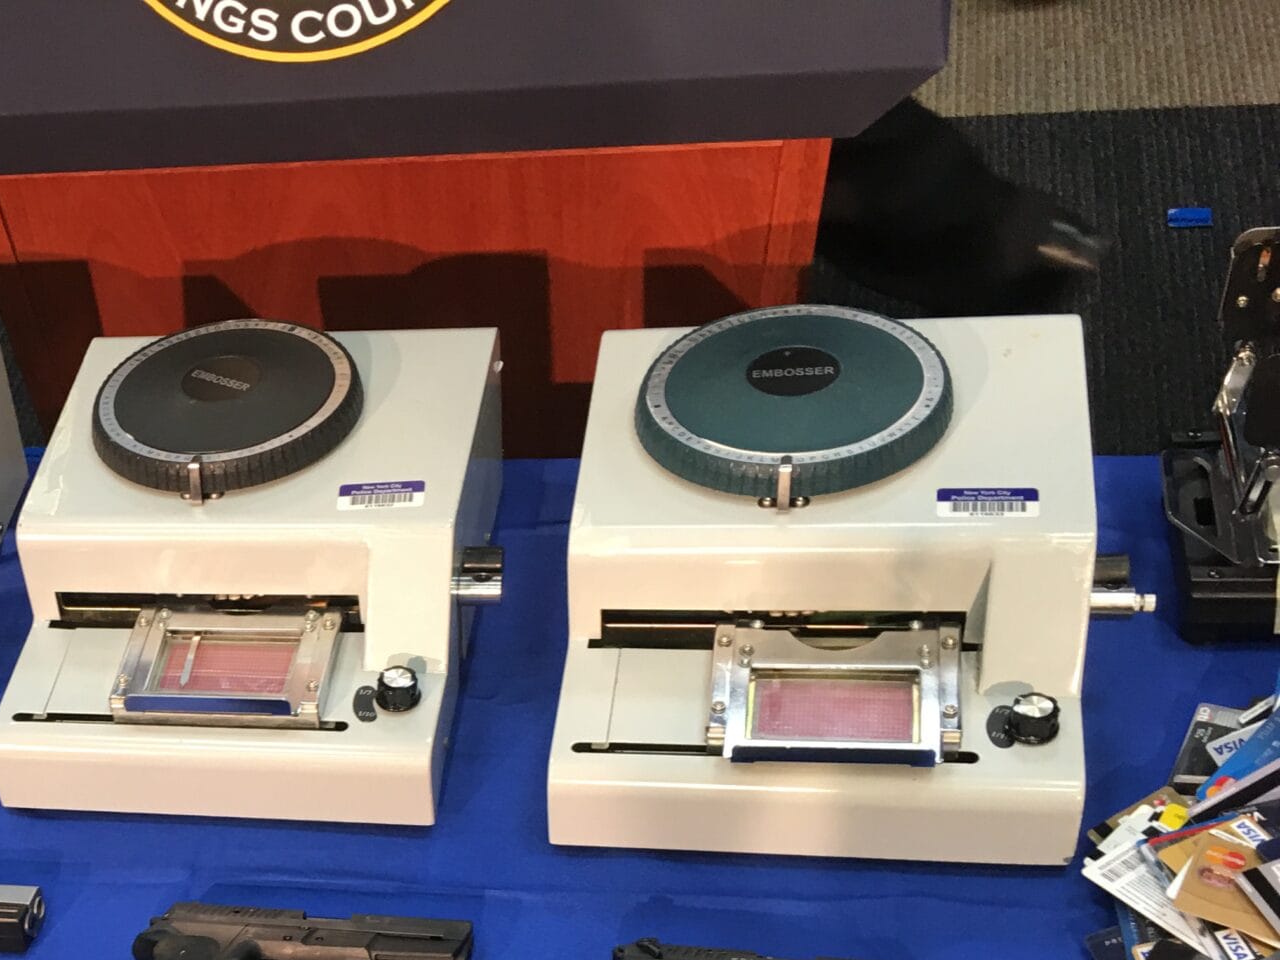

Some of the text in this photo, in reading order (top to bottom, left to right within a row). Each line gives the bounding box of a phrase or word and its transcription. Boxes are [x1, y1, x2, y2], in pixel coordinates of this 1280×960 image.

[290, 0, 415, 44] COU
[191, 369, 251, 392] EMBOSSER
[752, 366, 835, 378] EMBOSSER
[1213, 737, 1246, 756] VISA
[1222, 934, 1249, 960] VISA
